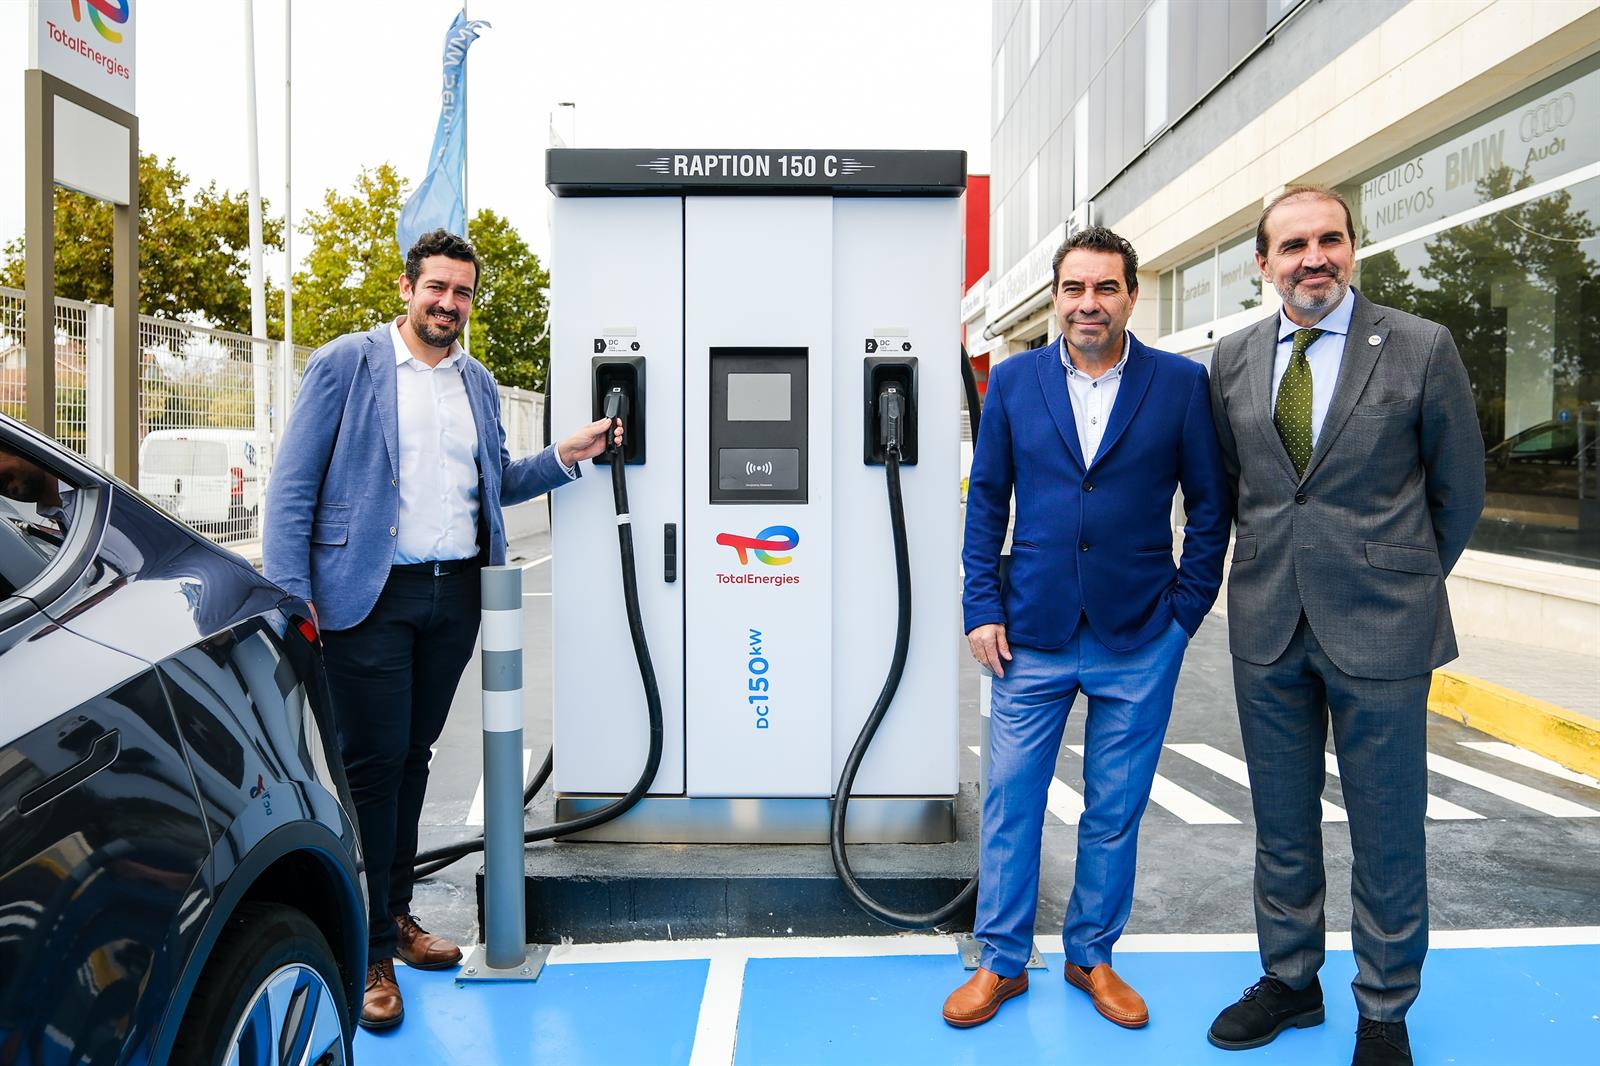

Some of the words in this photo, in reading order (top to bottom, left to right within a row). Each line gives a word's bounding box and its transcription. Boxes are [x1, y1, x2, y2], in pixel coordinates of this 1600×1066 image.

[46, 20, 130, 80] TotalEnergies
[673, 154, 770, 177] RAPTION
[777, 155, 817, 177] 150
[823, 155, 838, 177] C
[1445, 129, 1505, 192] BMW
[1525, 137, 1566, 166] Audi
[1357, 158, 1423, 203] HICULOS
[1376, 187, 1434, 228] NUEVOS
[867, 342, 873, 350] 2
[716, 573, 800, 587] TotalEnergies
